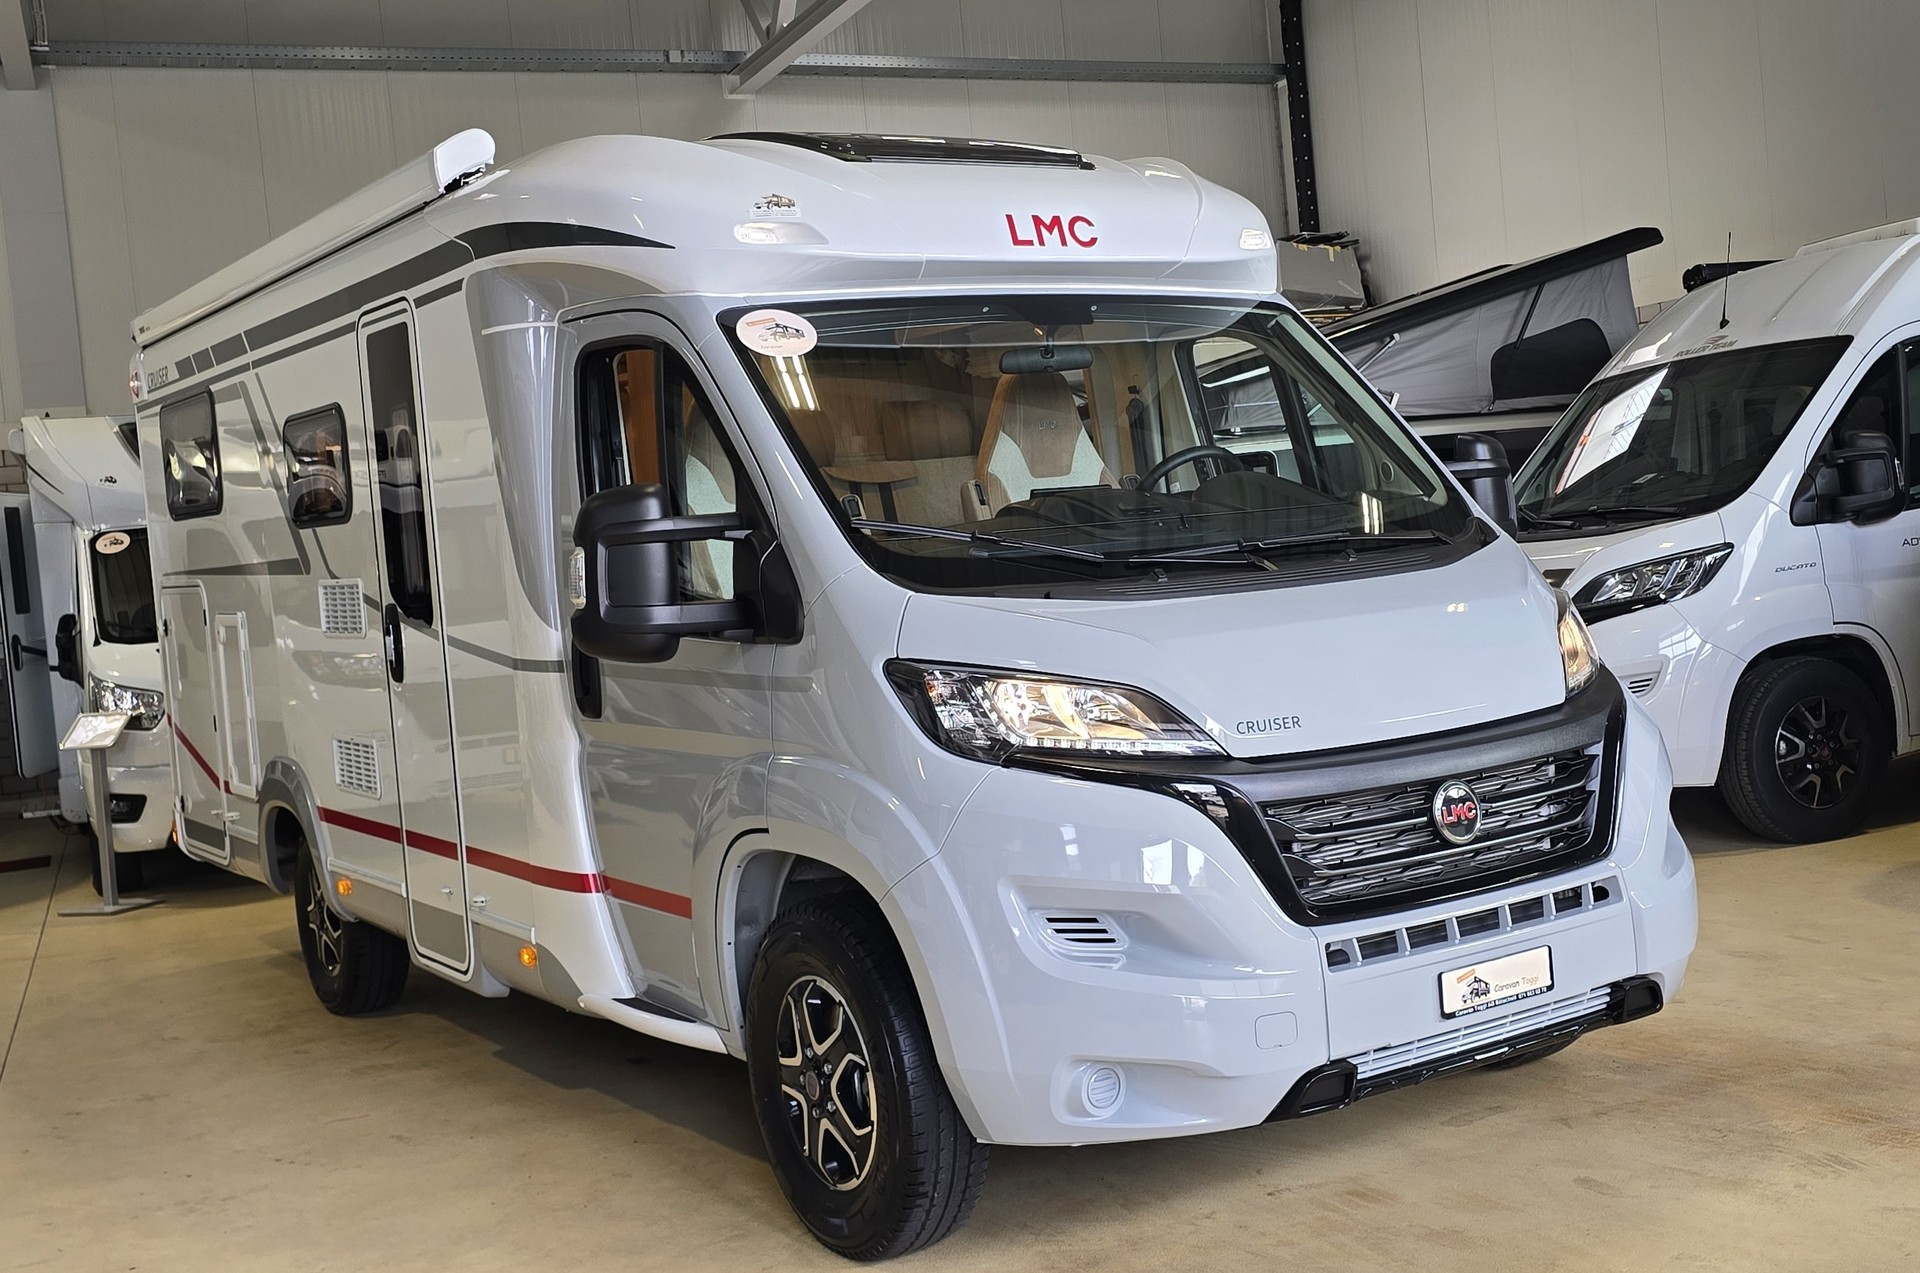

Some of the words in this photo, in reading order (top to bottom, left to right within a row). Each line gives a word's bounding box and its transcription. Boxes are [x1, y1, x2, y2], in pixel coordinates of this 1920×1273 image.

[1005, 214, 1098, 248] LMC
[148, 366, 169, 388] CRUISER
[1902, 537, 1920, 547] AD
[1775, 562, 1817, 573] DUCATO
[1236, 715, 1302, 735] CRUISER
[1442, 801, 1477, 824] LMC
[1494, 981, 1520, 992] Caravan
